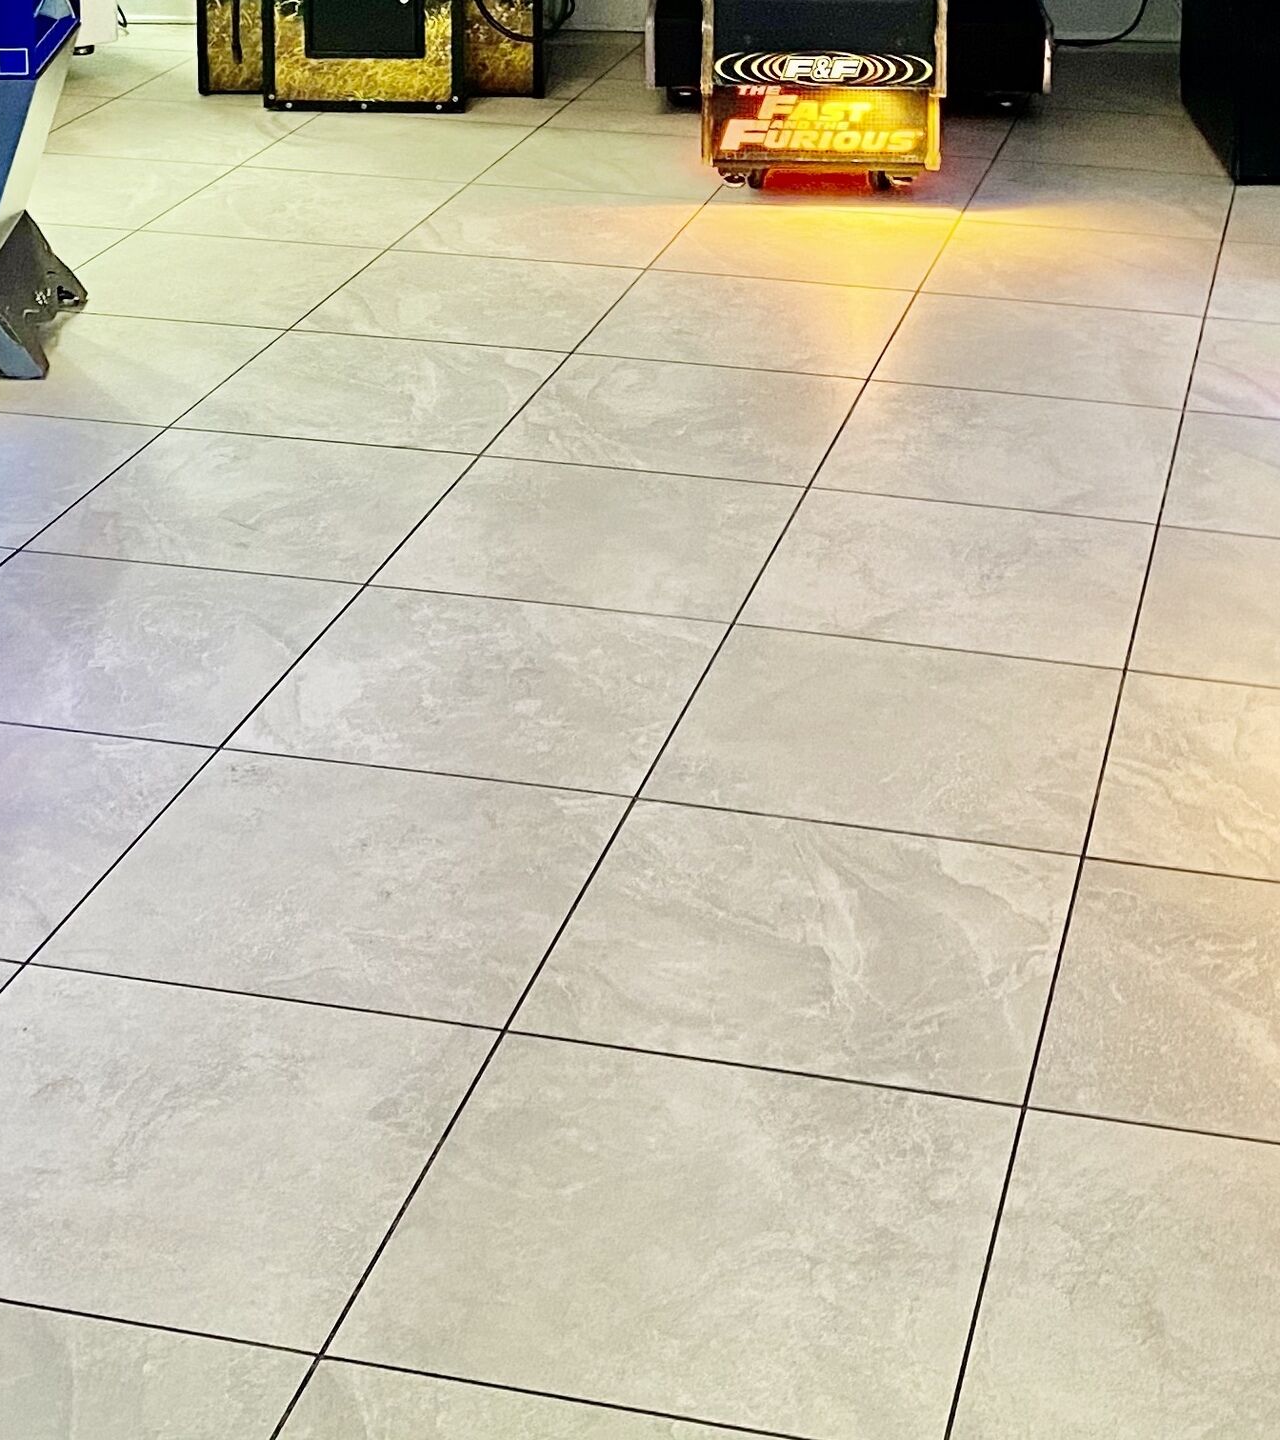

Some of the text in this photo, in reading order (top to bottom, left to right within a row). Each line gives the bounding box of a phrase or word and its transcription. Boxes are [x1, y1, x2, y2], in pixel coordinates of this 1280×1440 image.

[781, 55, 863, 80] F&F
[737, 85, 782, 96] THE
[757, 94, 873, 122] FAST
[720, 119, 924, 153] FURIOUS
[770, 120, 850, 131] AND THE
